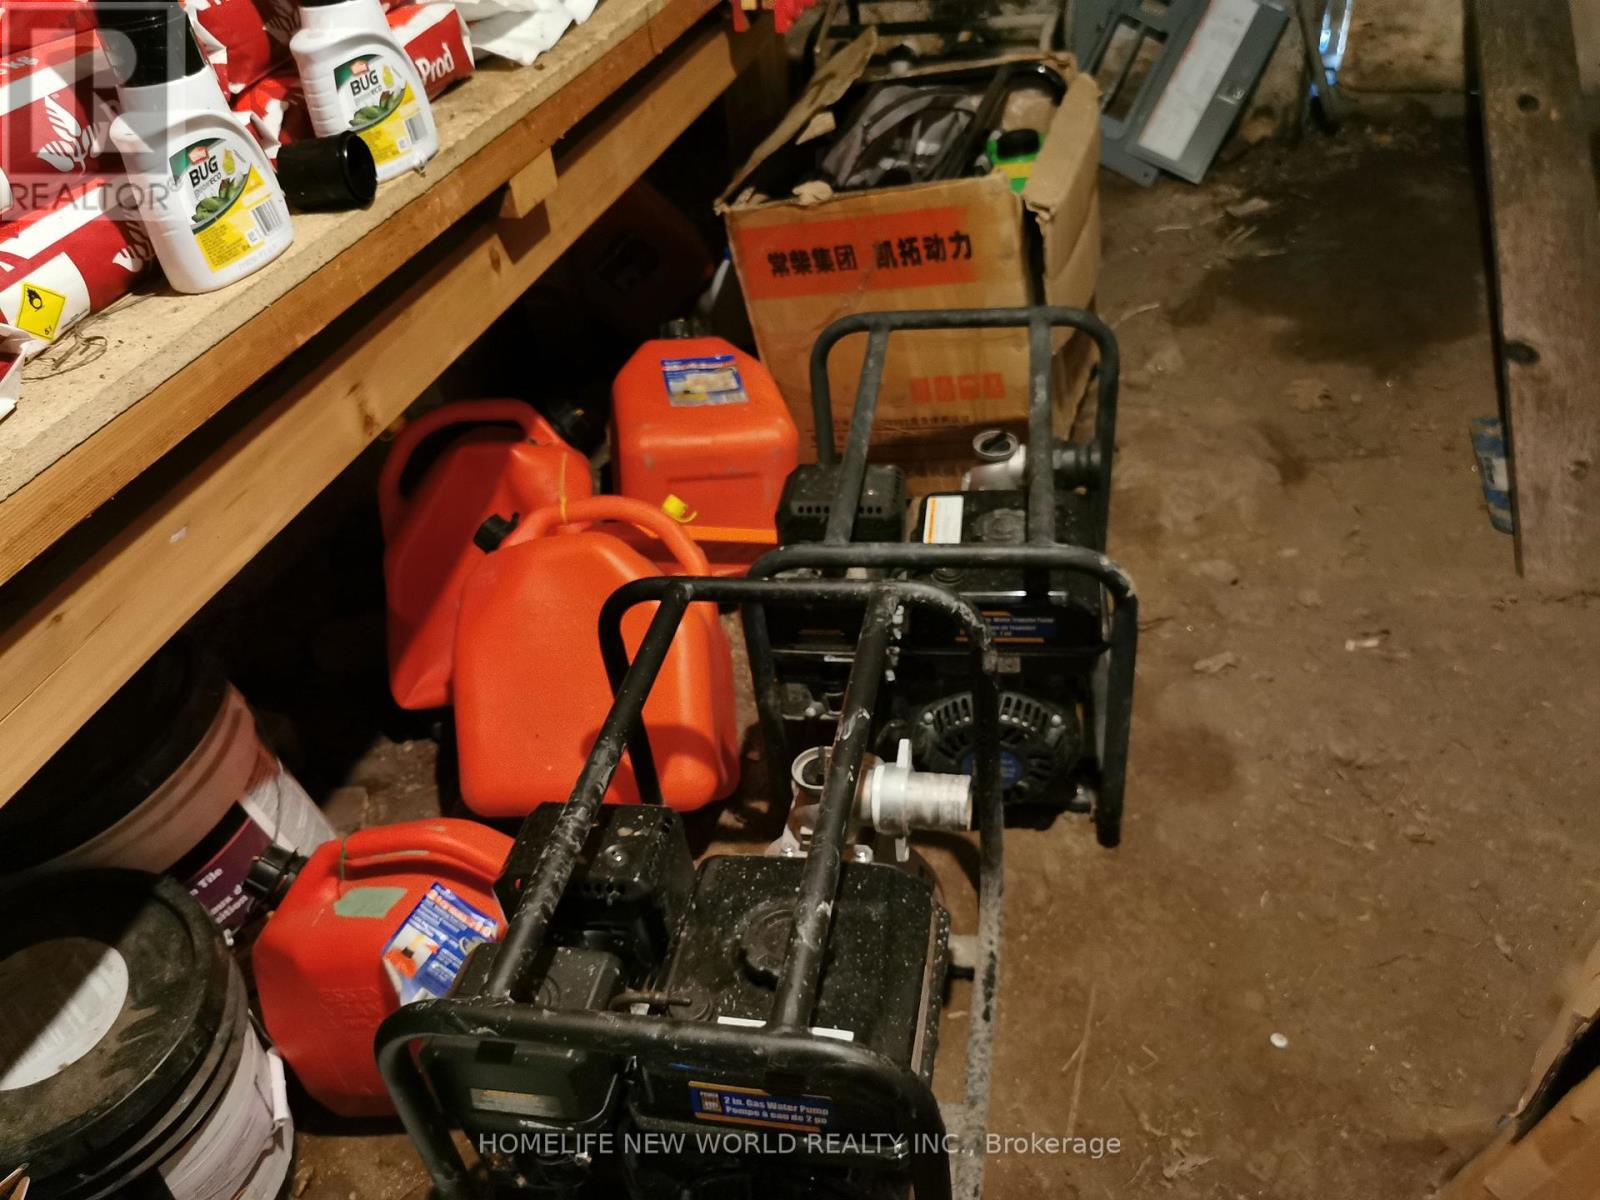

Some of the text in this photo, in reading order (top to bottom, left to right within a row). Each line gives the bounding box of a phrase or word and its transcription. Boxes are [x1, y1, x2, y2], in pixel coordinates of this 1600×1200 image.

[350, 70, 379, 96] BUG
[189, 155, 219, 188] BUG
[873, 230, 973, 270] 凯拓动力
[723, 1096, 730, 1104] 2
[746, 1099, 766, 1109] Gas
[767, 1101, 798, 1113] Water
[799, 1104, 829, 1116] Pump
[806, 1114, 812, 1122] 2
